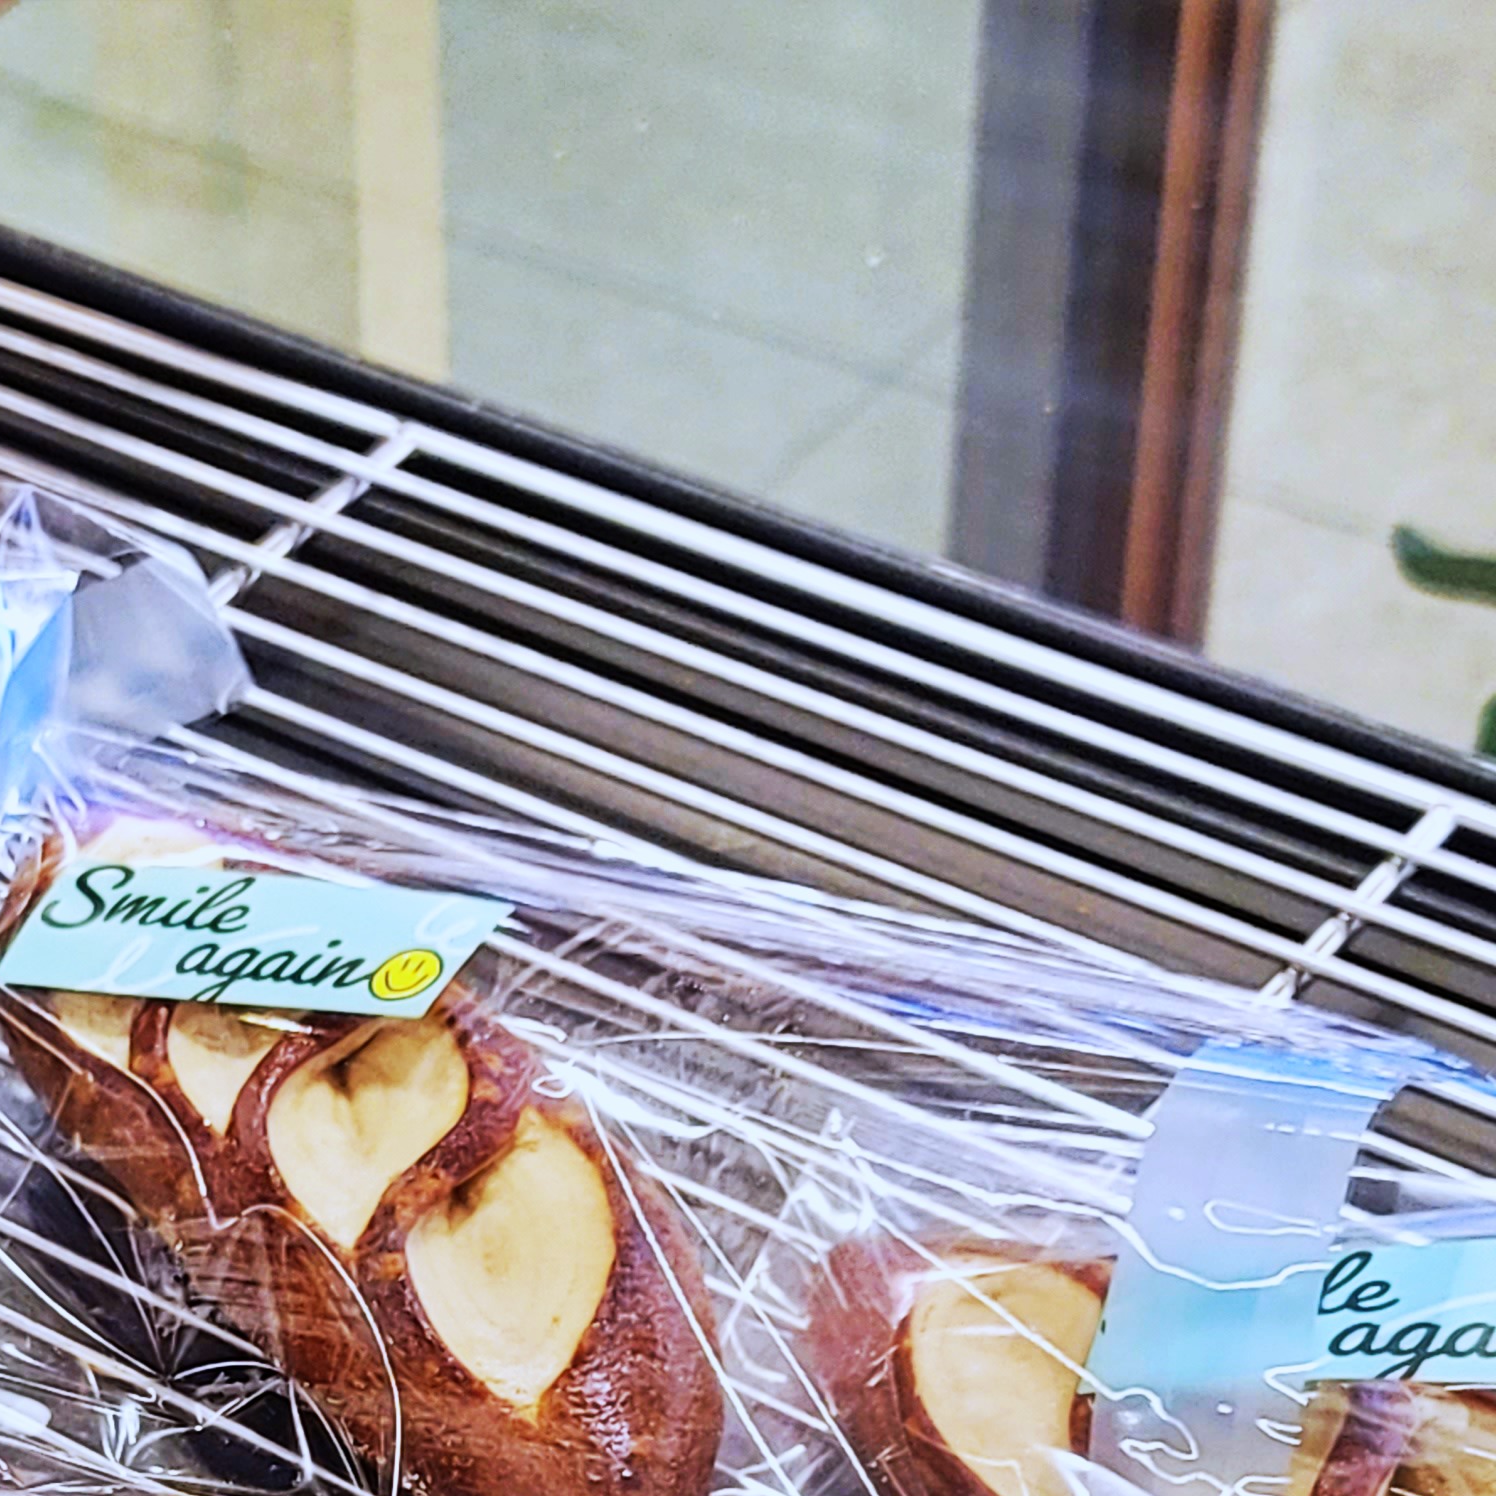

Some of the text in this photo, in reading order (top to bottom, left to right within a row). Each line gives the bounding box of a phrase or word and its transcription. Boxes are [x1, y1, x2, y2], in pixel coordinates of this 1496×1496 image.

[41, 865, 256, 934] Smile
[176, 940, 371, 1001] again
[1328, 1321, 1496, 1381] aga
